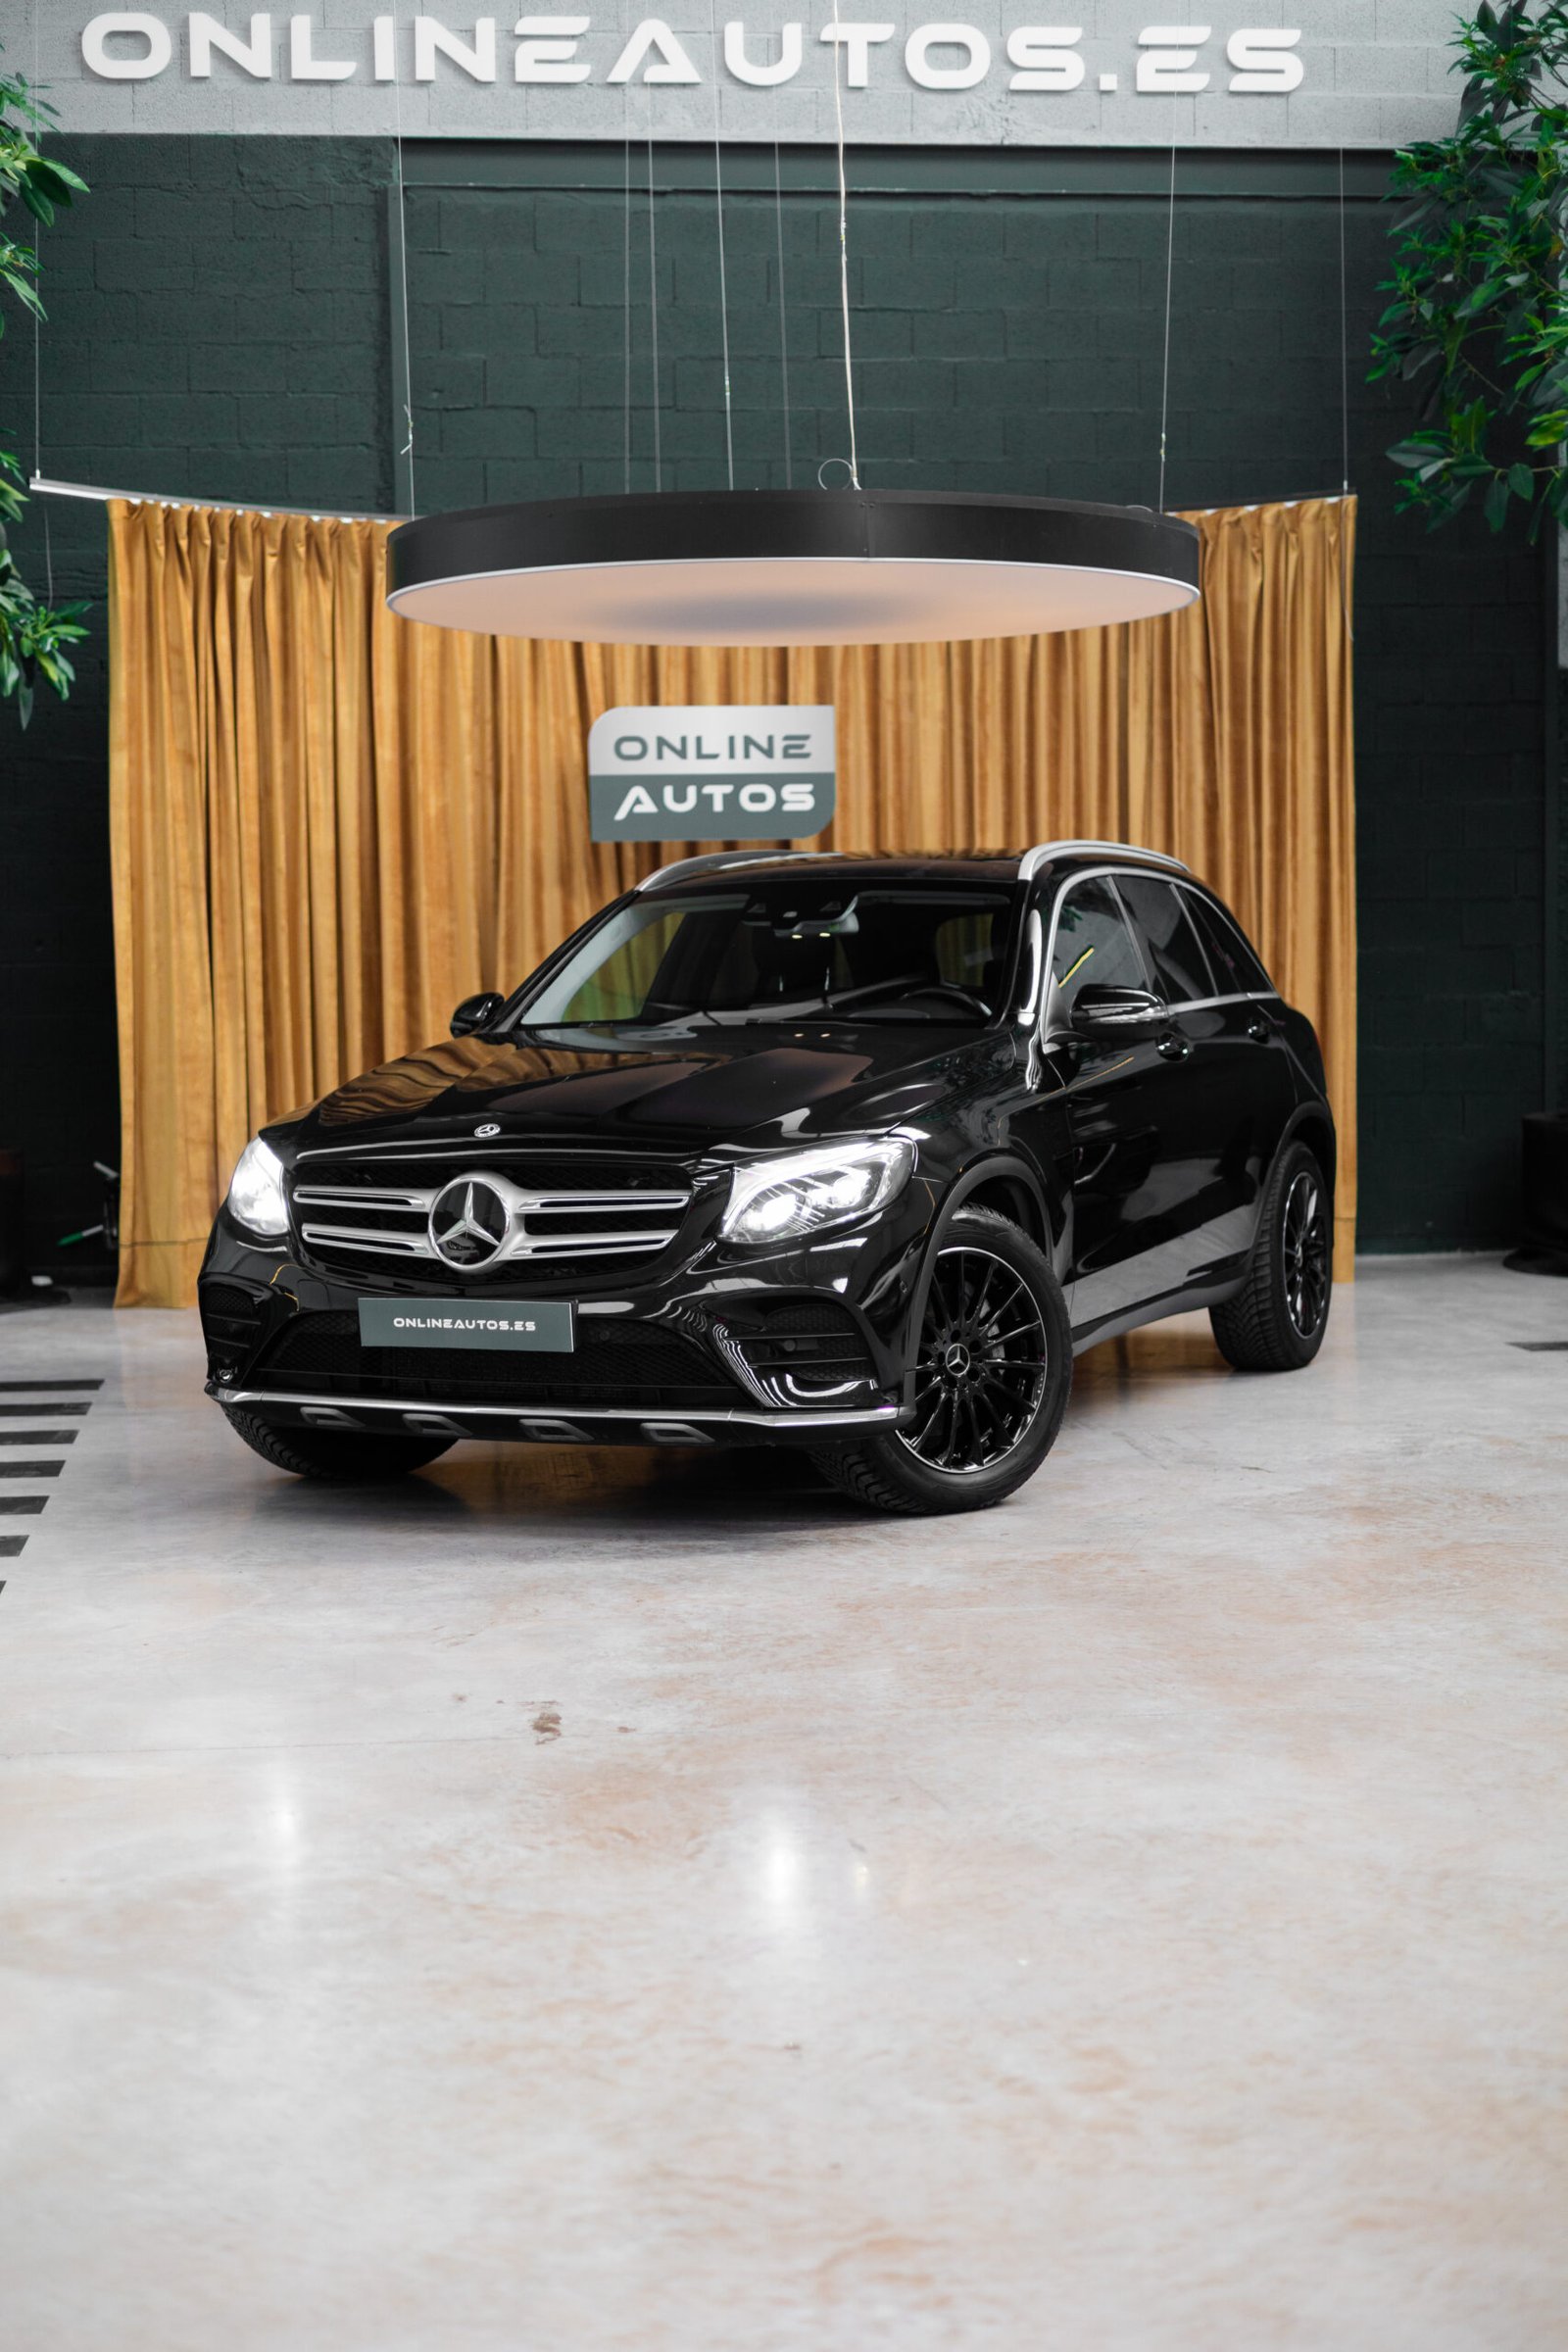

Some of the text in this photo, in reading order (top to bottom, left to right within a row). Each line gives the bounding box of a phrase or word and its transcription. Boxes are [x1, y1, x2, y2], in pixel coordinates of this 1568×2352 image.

[81, 12, 1305, 93] ONLINEAUTOS.ES
[613, 735, 811, 760] ONLINE
[613, 783, 815, 821] AUTOS
[393, 1317, 536, 1331] ONLINEAUTOS.ES
